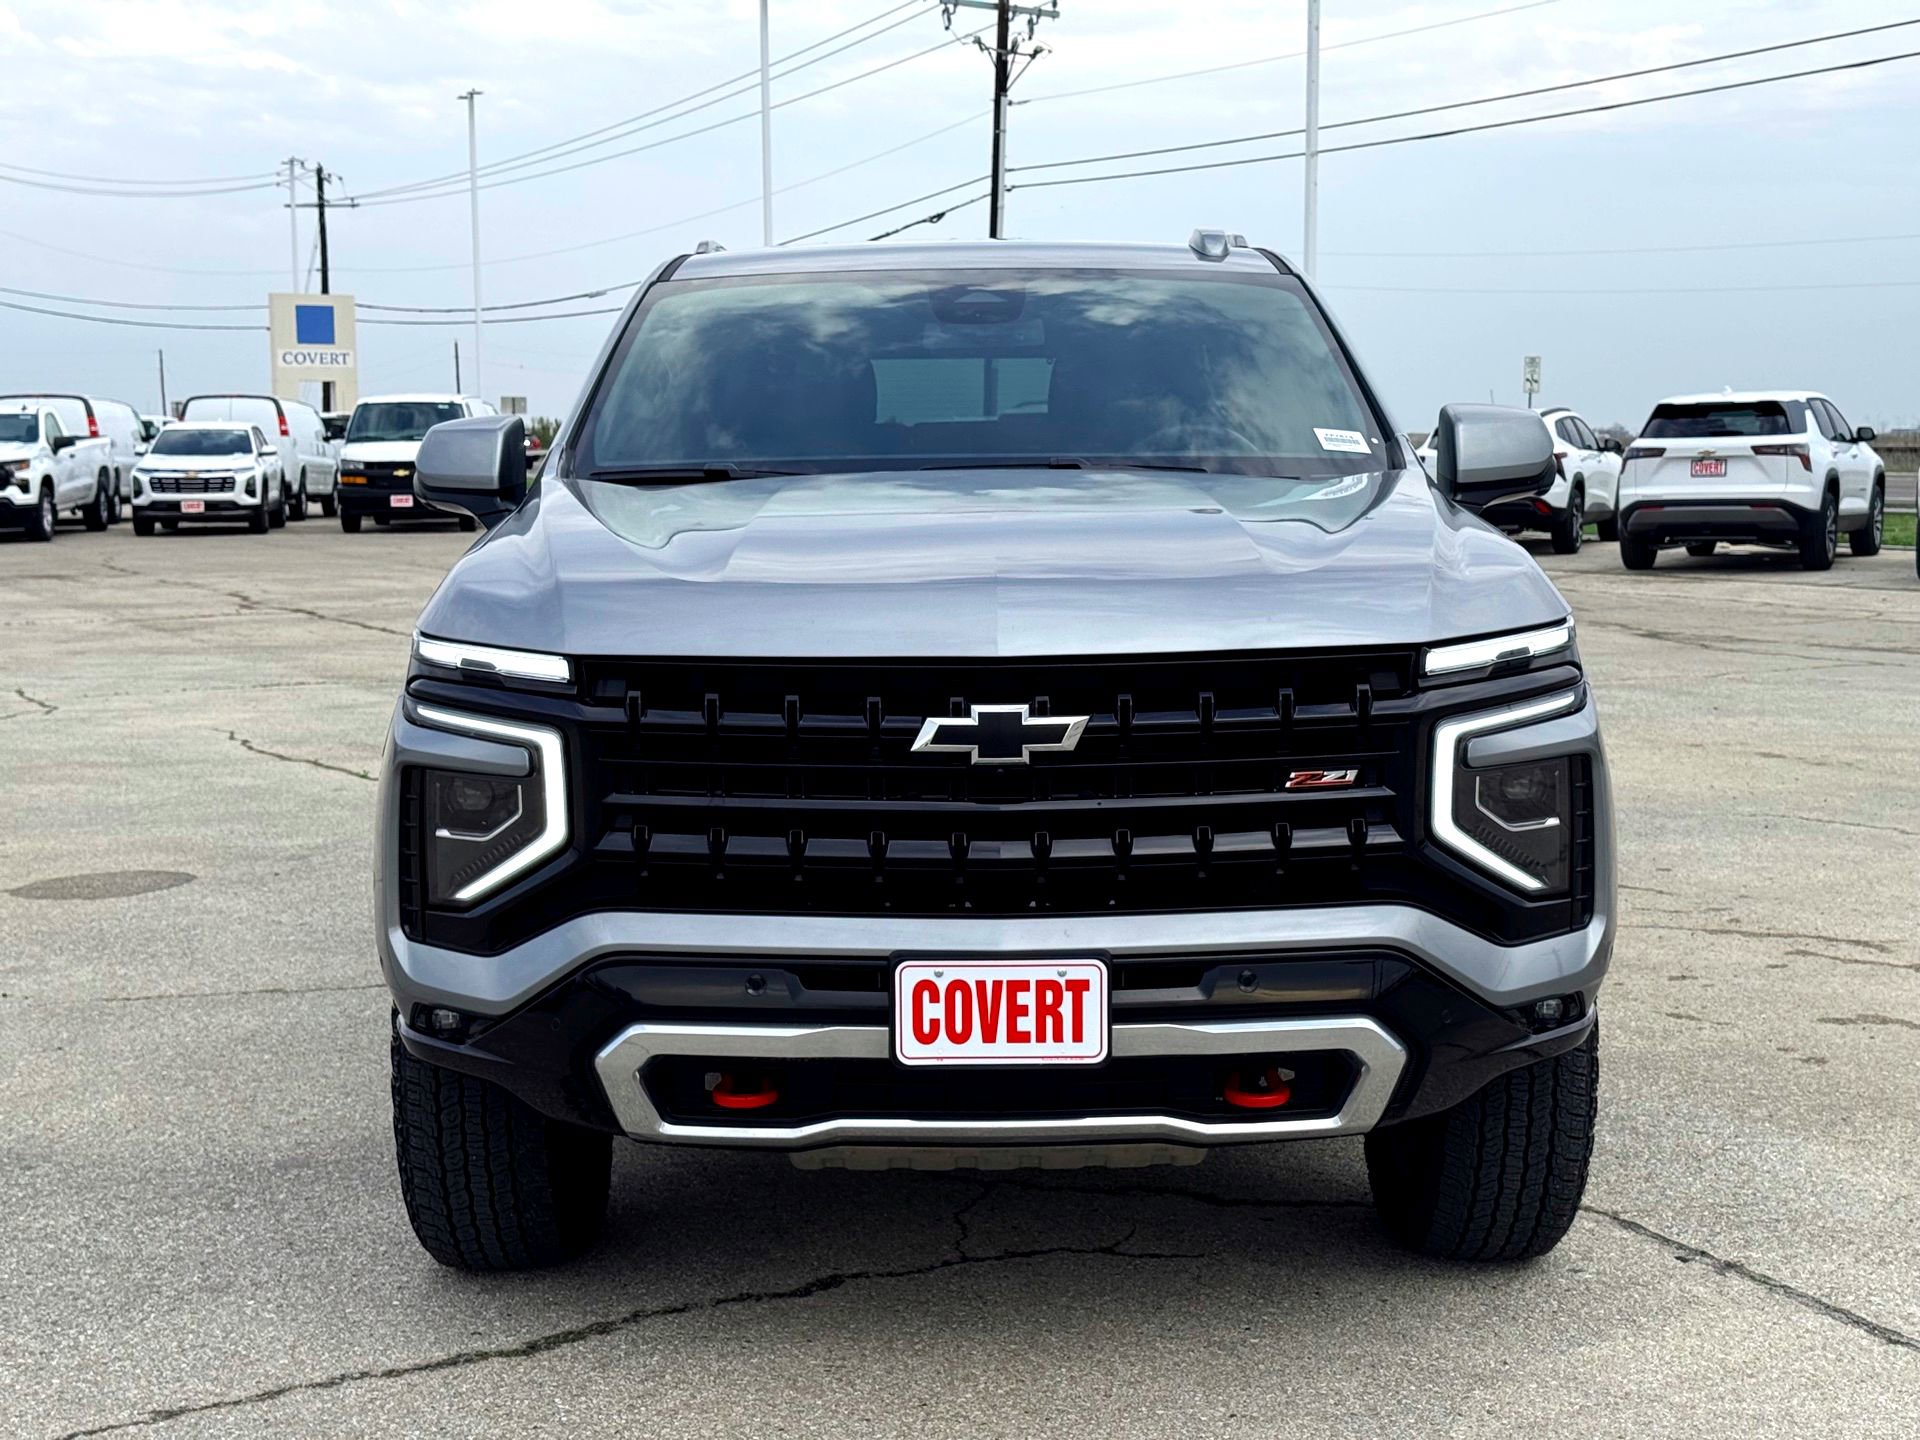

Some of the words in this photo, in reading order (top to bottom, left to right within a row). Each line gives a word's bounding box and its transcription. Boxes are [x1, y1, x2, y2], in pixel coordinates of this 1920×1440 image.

[282, 351, 350, 365] COVERT
[1694, 462, 1723, 473] COVERT
[1285, 769, 1359, 788] Z71
[912, 979, 1090, 1045] COVERT
